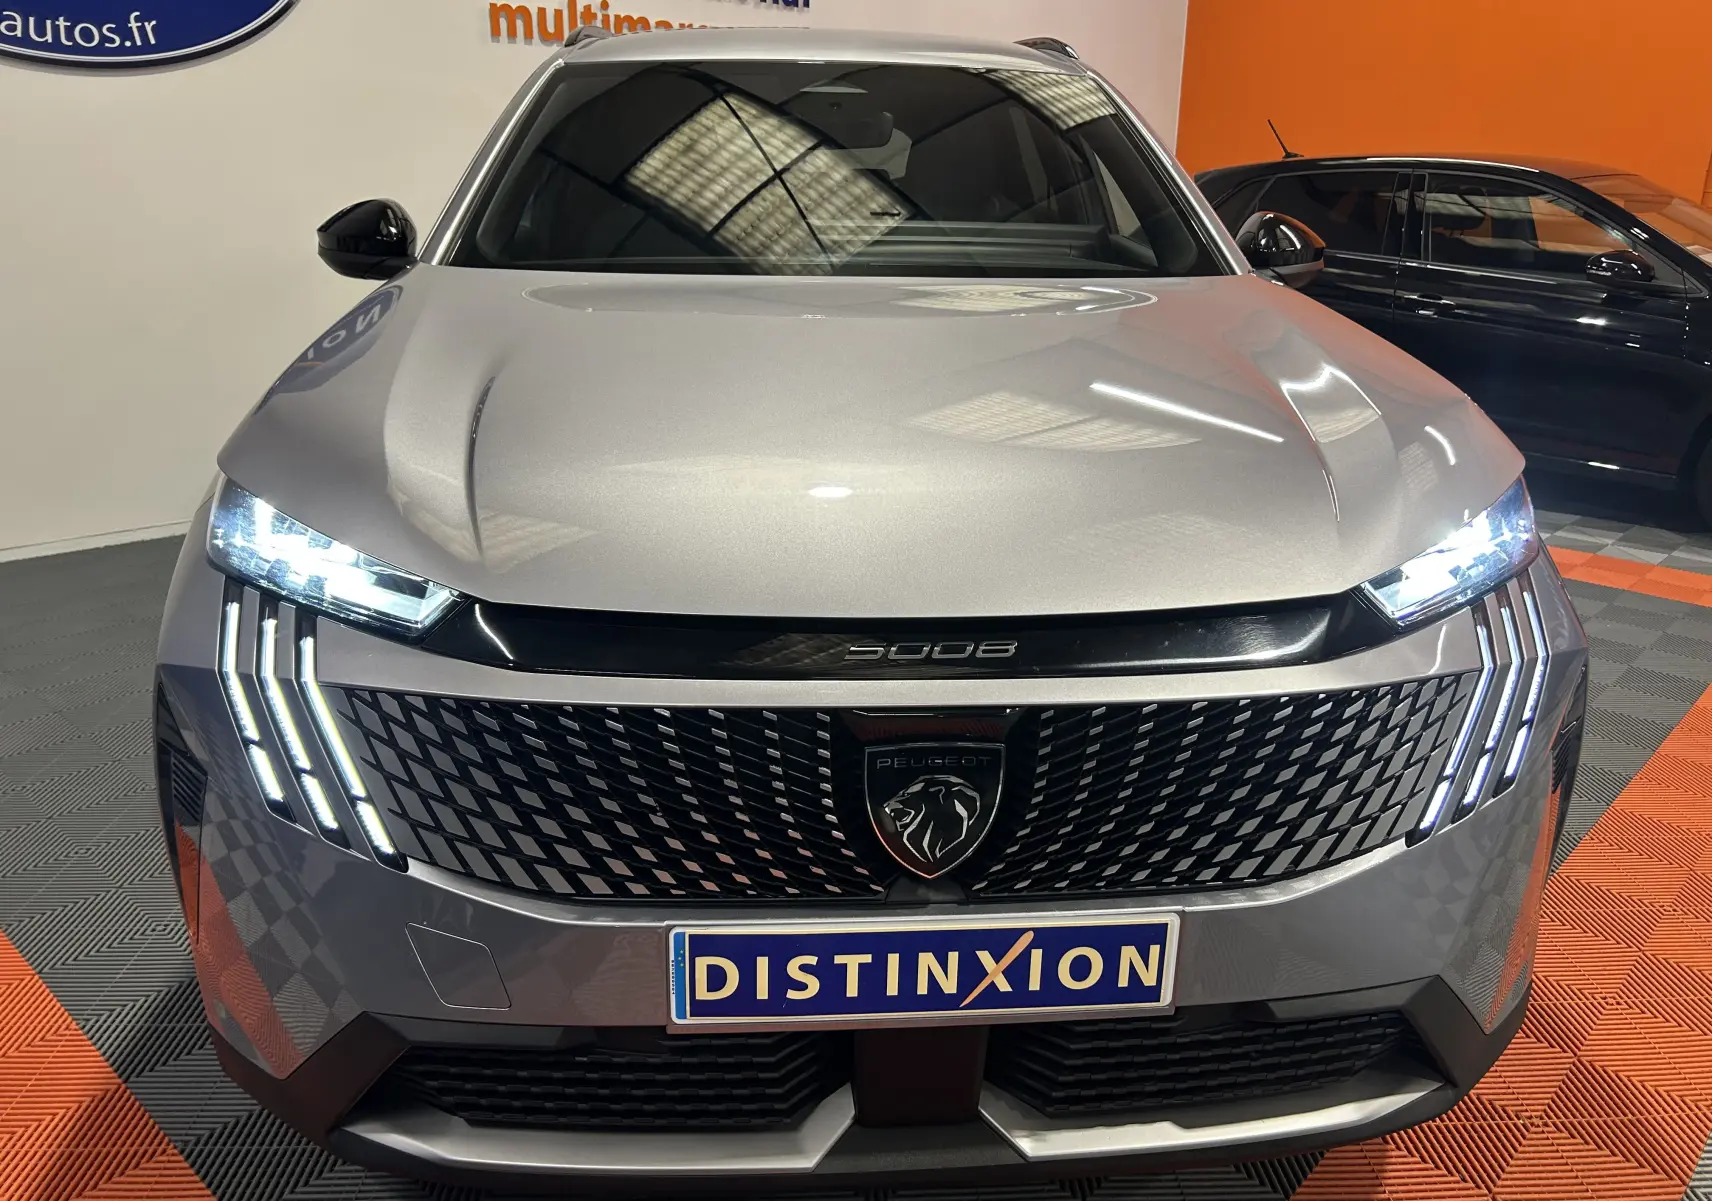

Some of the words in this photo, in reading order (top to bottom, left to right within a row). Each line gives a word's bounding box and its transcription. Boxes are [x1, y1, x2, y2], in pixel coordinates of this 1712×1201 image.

[0, 11, 157, 47] autos.fr
[844, 640, 1018, 660] 5008
[876, 755, 992, 770] PEUGEOT
[694, 931, 1162, 1008] DISTINXION
